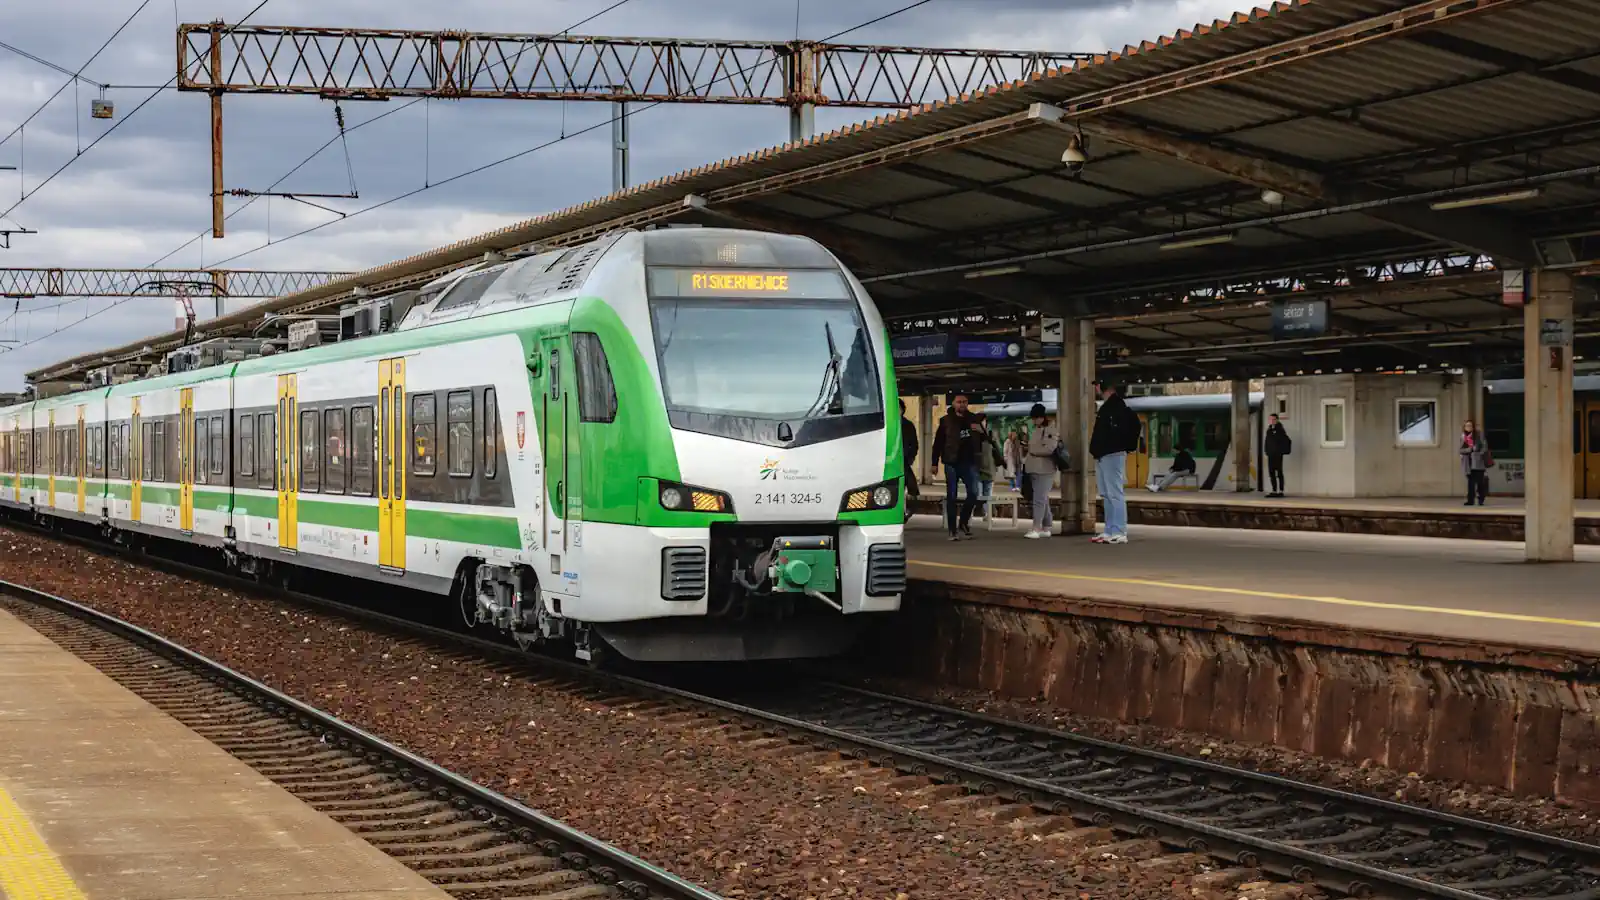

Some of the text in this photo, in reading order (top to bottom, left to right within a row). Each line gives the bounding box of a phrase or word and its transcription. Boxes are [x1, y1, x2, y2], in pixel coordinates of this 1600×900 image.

[692, 273, 788, 290] R1 SKIERNIEWICE
[755, 493, 822, 505] 2 141 324-5
